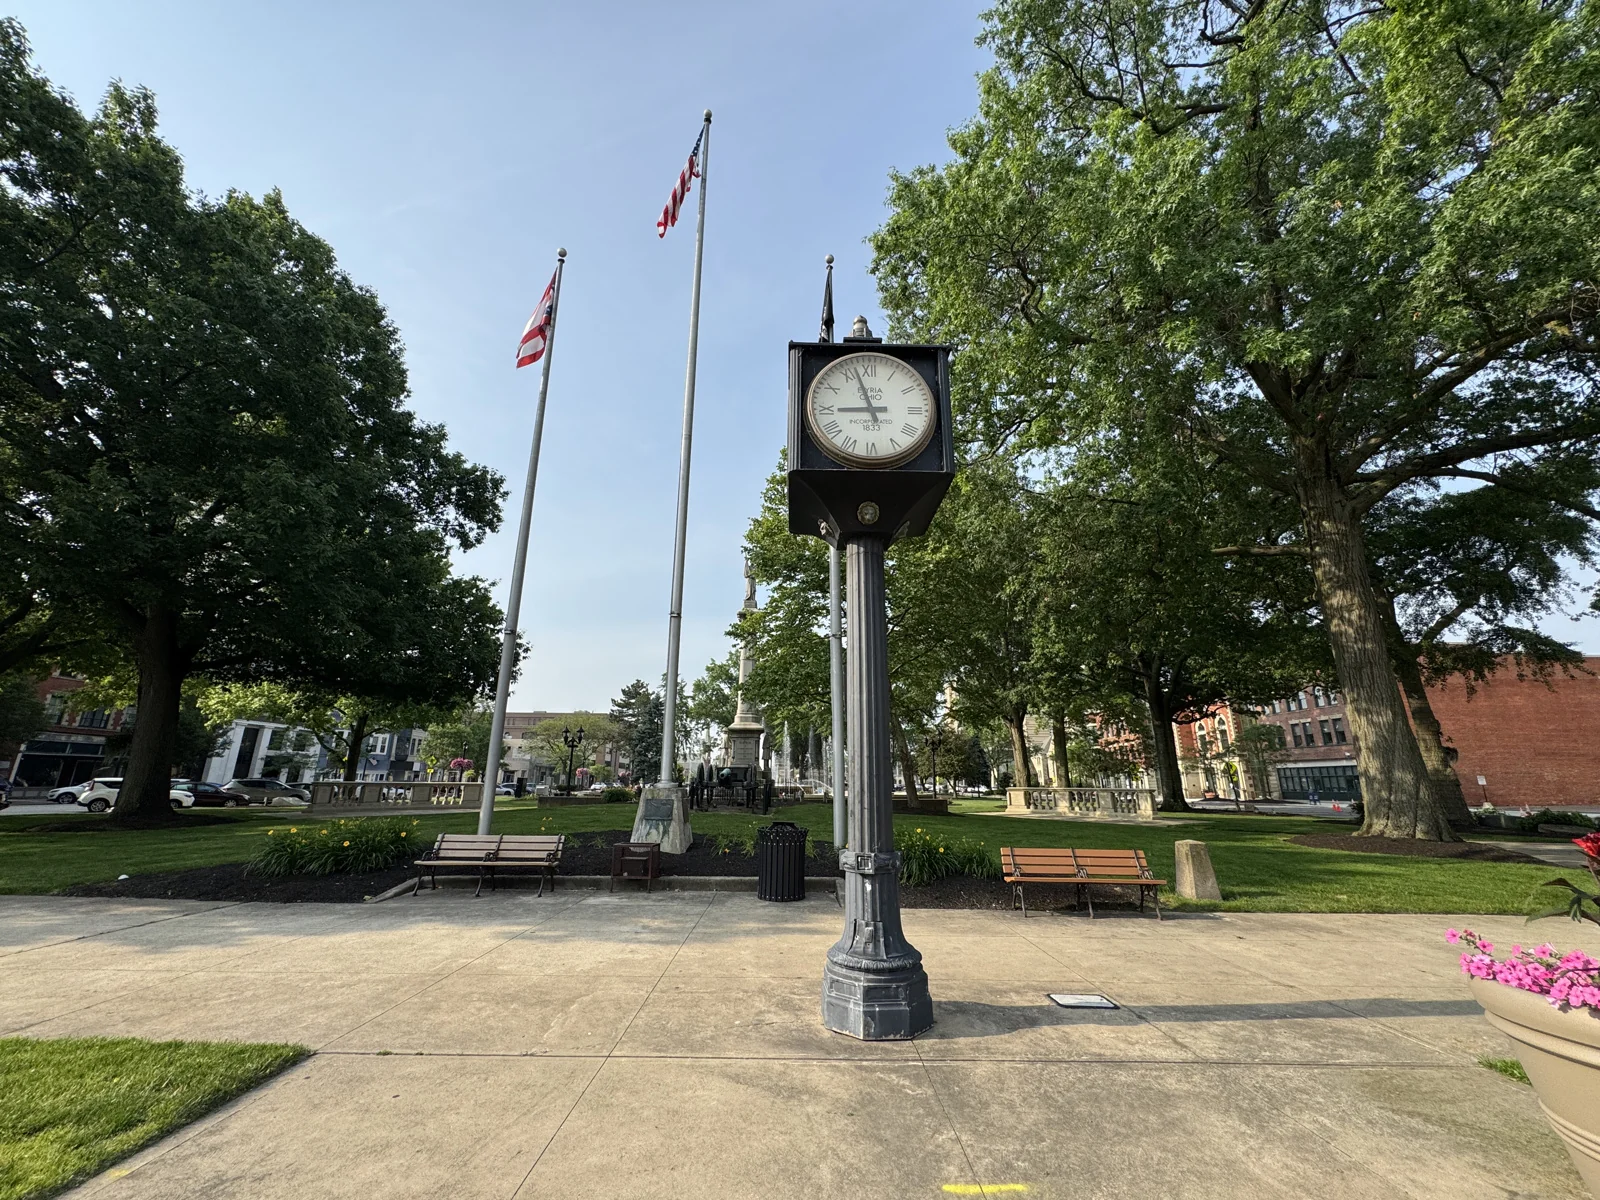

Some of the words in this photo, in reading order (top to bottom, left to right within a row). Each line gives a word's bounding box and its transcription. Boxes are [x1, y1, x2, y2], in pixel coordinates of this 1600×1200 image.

[840, 367, 856, 383] XI
[862, 364, 876, 378] XII
[887, 370, 896, 382] I
[824, 382, 841, 395] X
[901, 385, 916, 395] II
[819, 404, 834, 415] IX
[907, 406, 923, 415] III
[822, 419, 843, 440] VIII
[862, 424, 881, 432] 1833
[900, 422, 919, 439] IIII
[840, 435, 858, 453] VII
[866, 442, 878, 456] VI
[889, 437, 902, 451] V
